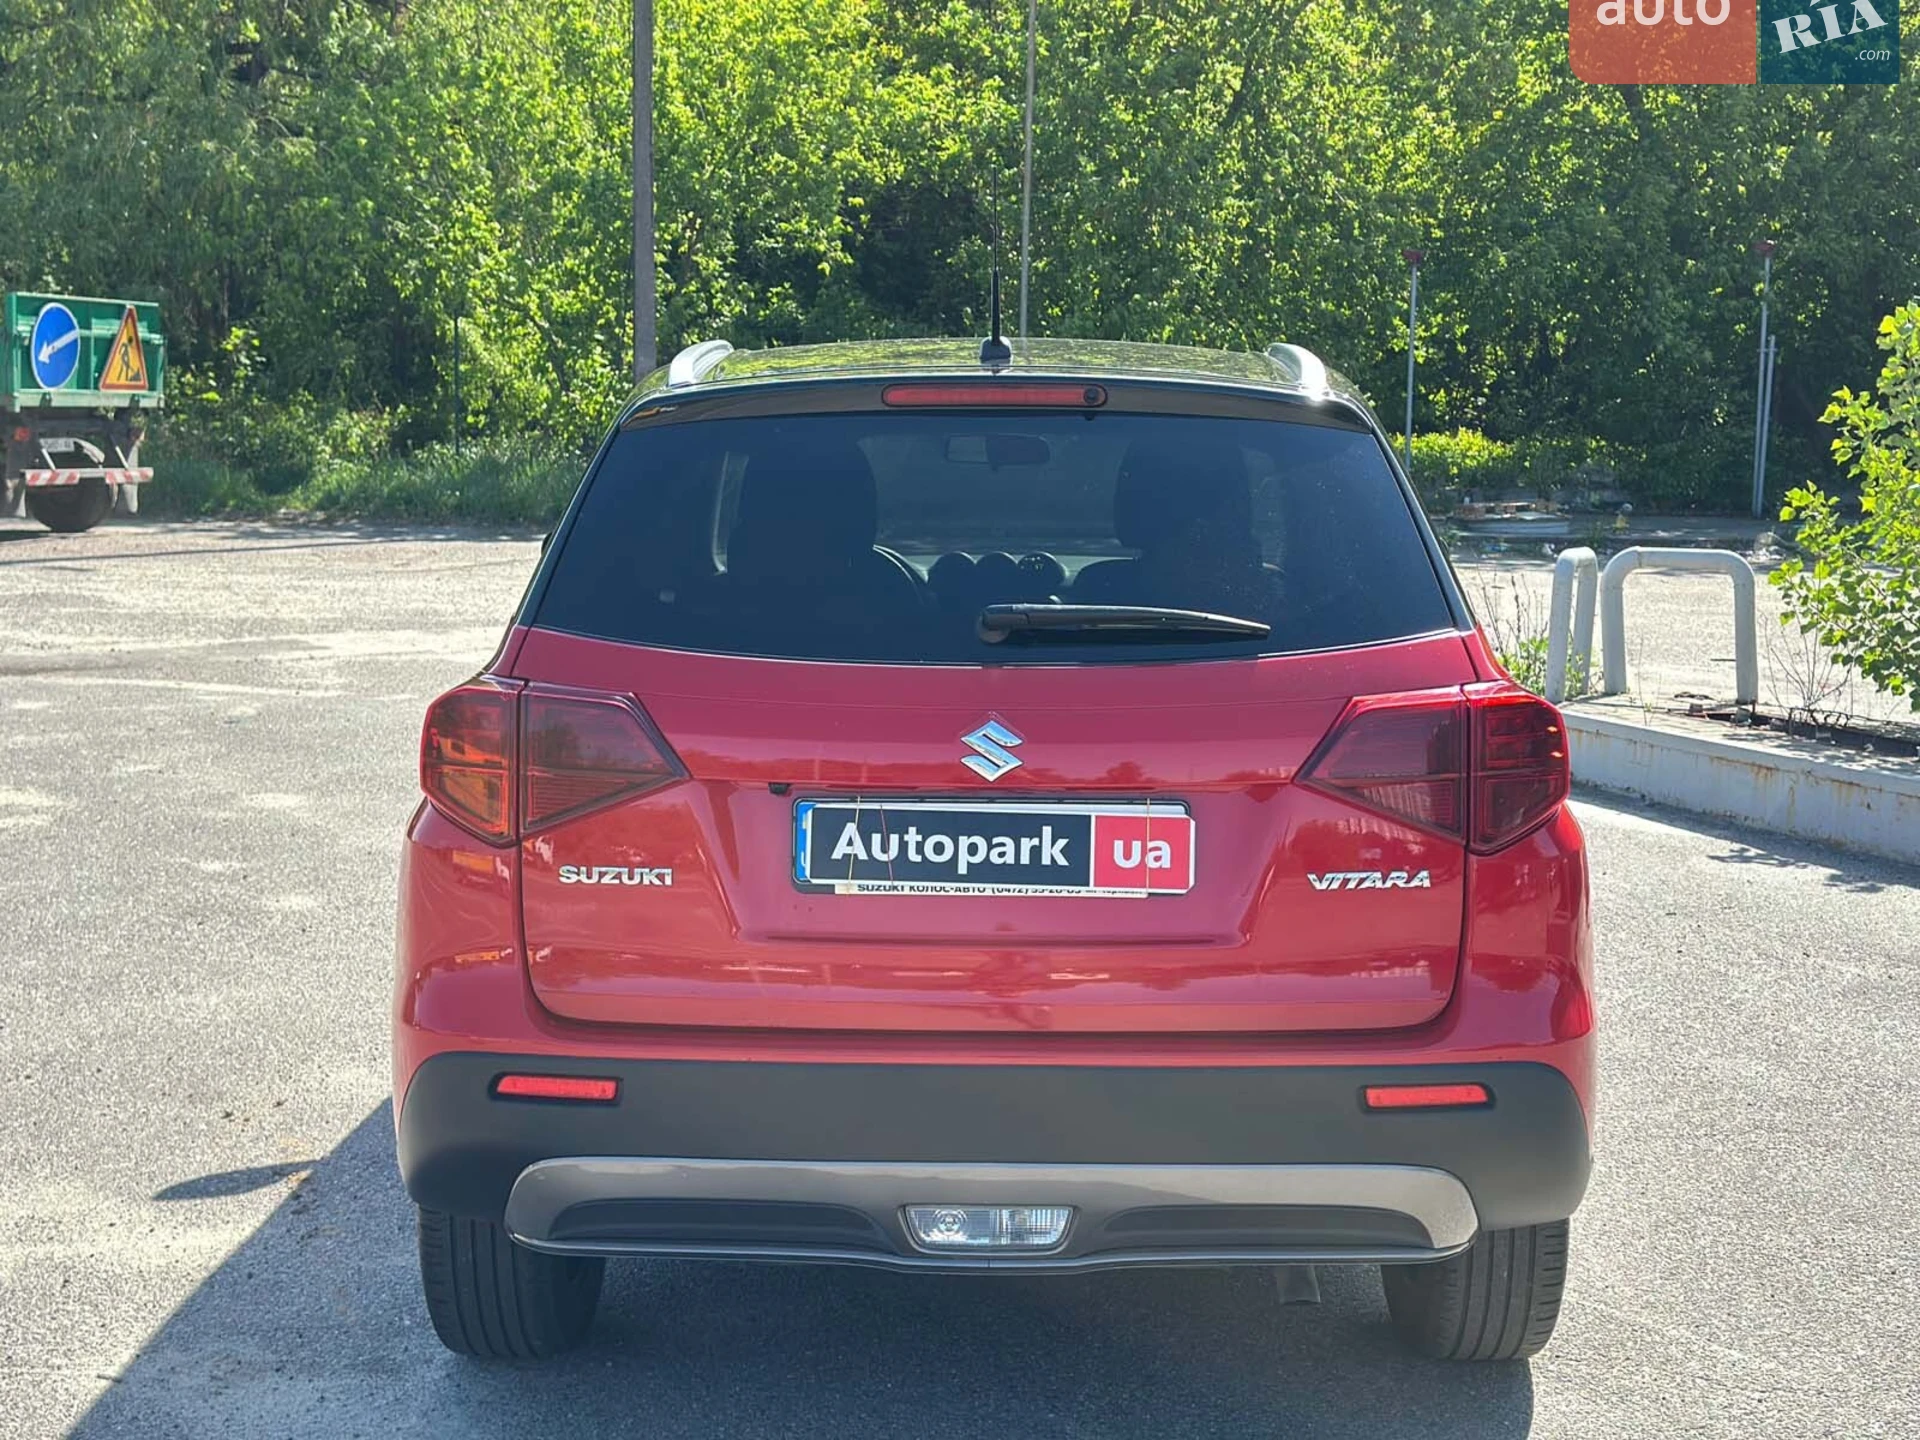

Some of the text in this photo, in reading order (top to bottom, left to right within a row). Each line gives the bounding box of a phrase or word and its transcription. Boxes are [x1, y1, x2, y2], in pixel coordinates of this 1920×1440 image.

[830, 821, 1070, 875] Autopark
[1113, 839, 1172, 869] ua
[558, 865, 673, 886] SUZUKI
[1306, 870, 1431, 890] VITARA
[857, 883, 905, 893] SUZUKI
